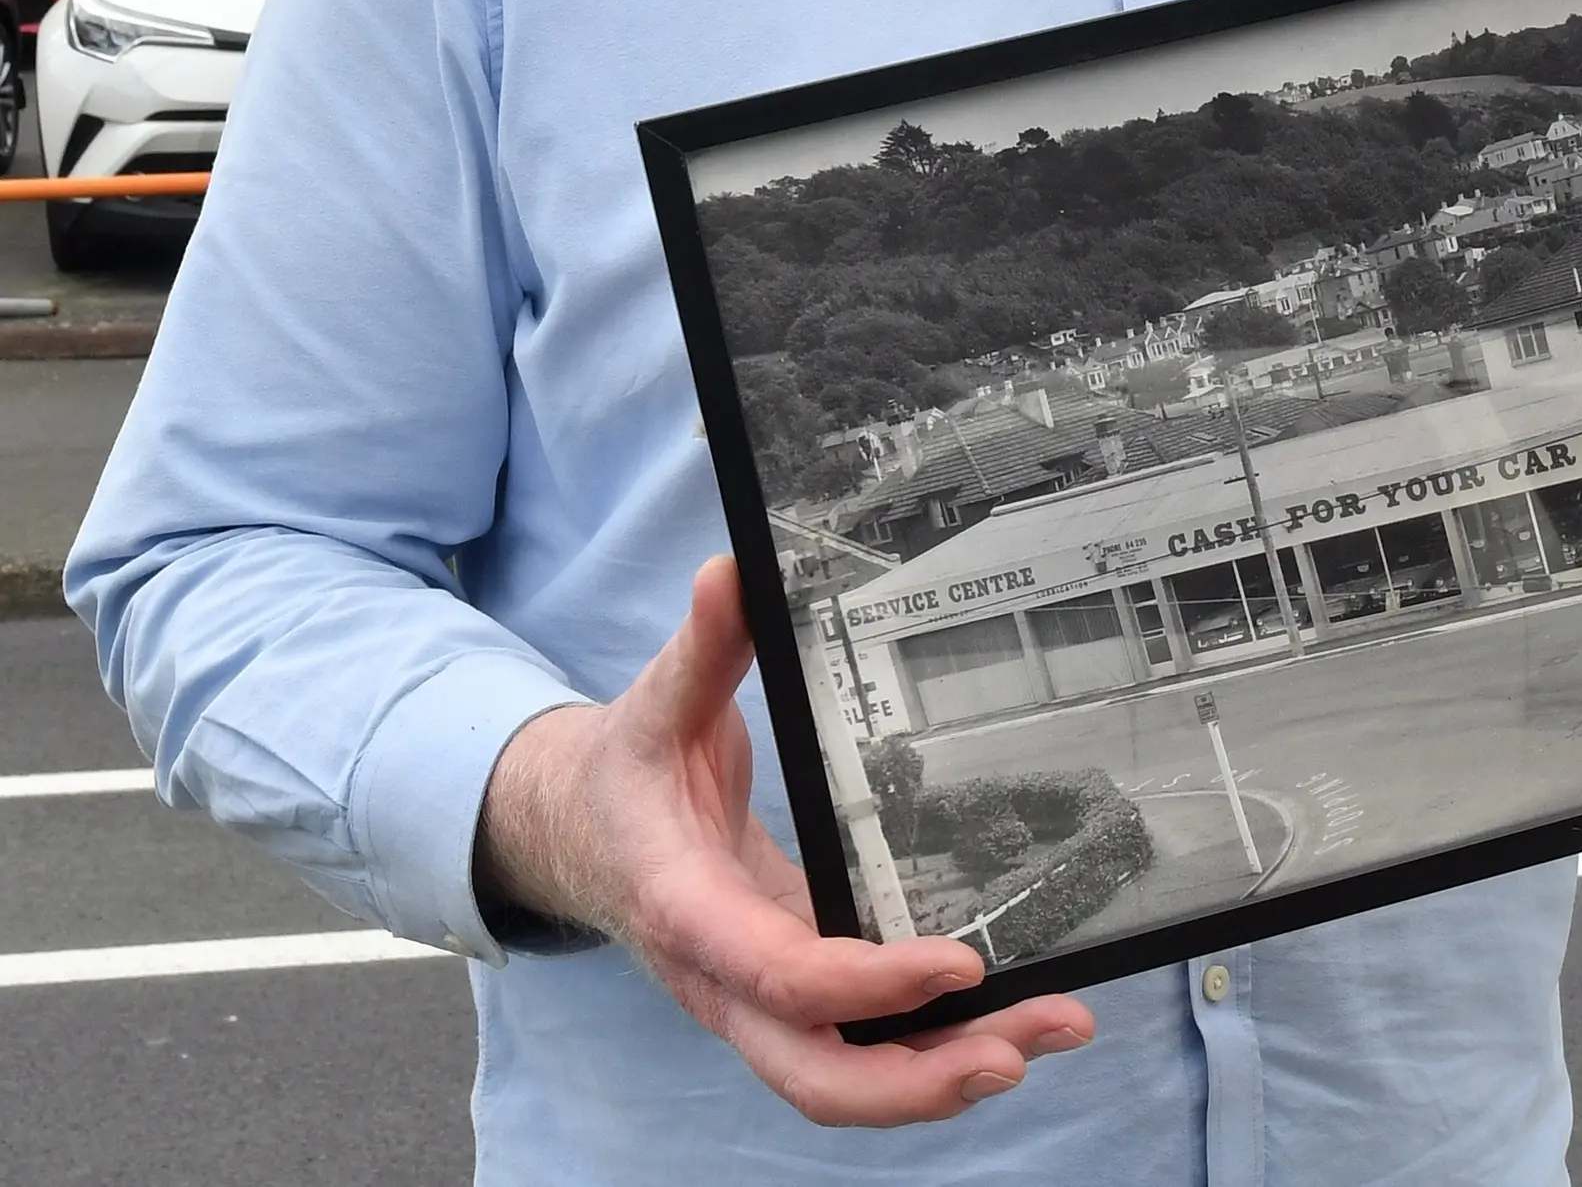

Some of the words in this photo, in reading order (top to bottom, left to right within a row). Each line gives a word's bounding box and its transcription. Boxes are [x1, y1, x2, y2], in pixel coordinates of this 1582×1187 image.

[1168, 515, 1262, 558] CASH
[1285, 493, 1367, 532] FOR
[1377, 464, 1486, 509] YOUR
[1498, 443, 1577, 481] CAR
[847, 589, 940, 628] SERVICE
[948, 566, 1037, 604] CENTRE
